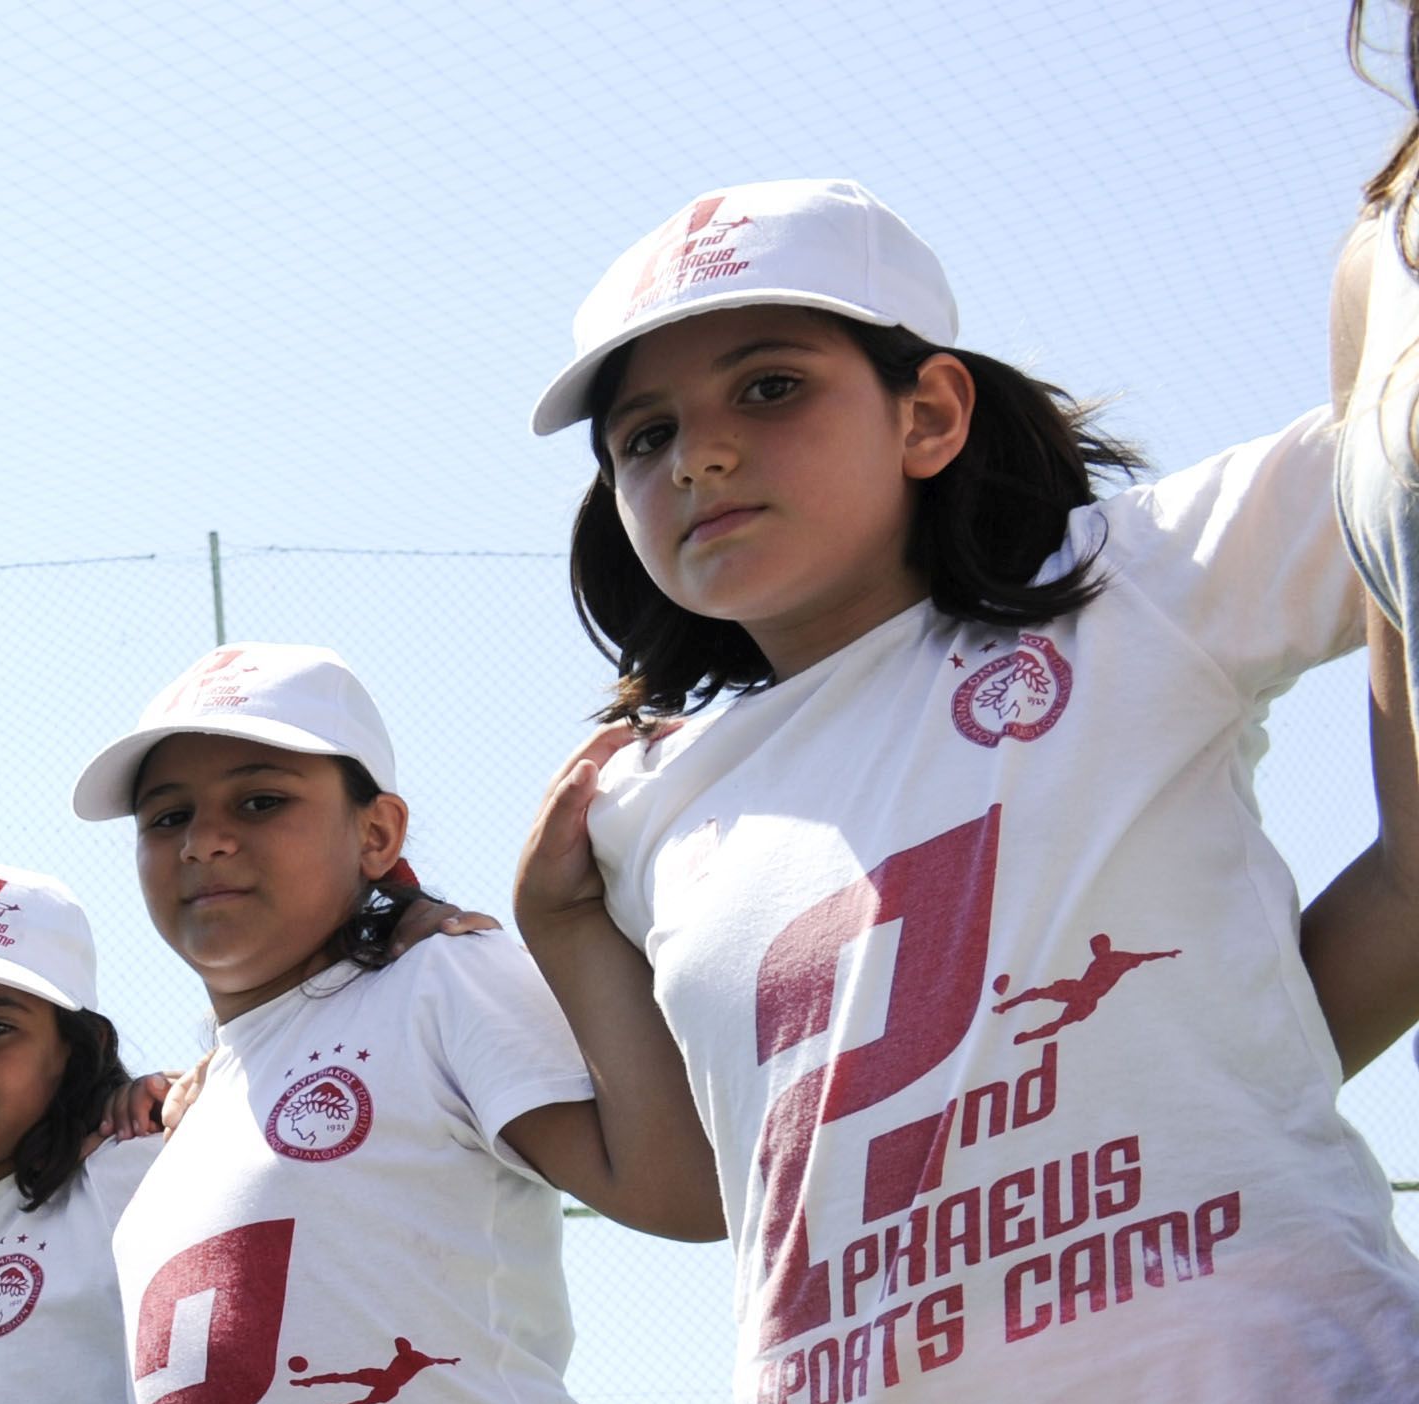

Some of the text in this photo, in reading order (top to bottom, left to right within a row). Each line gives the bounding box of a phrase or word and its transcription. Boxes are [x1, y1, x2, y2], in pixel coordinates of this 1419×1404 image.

[691, 261, 750, 284] CAMP
[326, 1125, 346, 1133] 1925
[1004, 1192, 1240, 1343] CAMP
